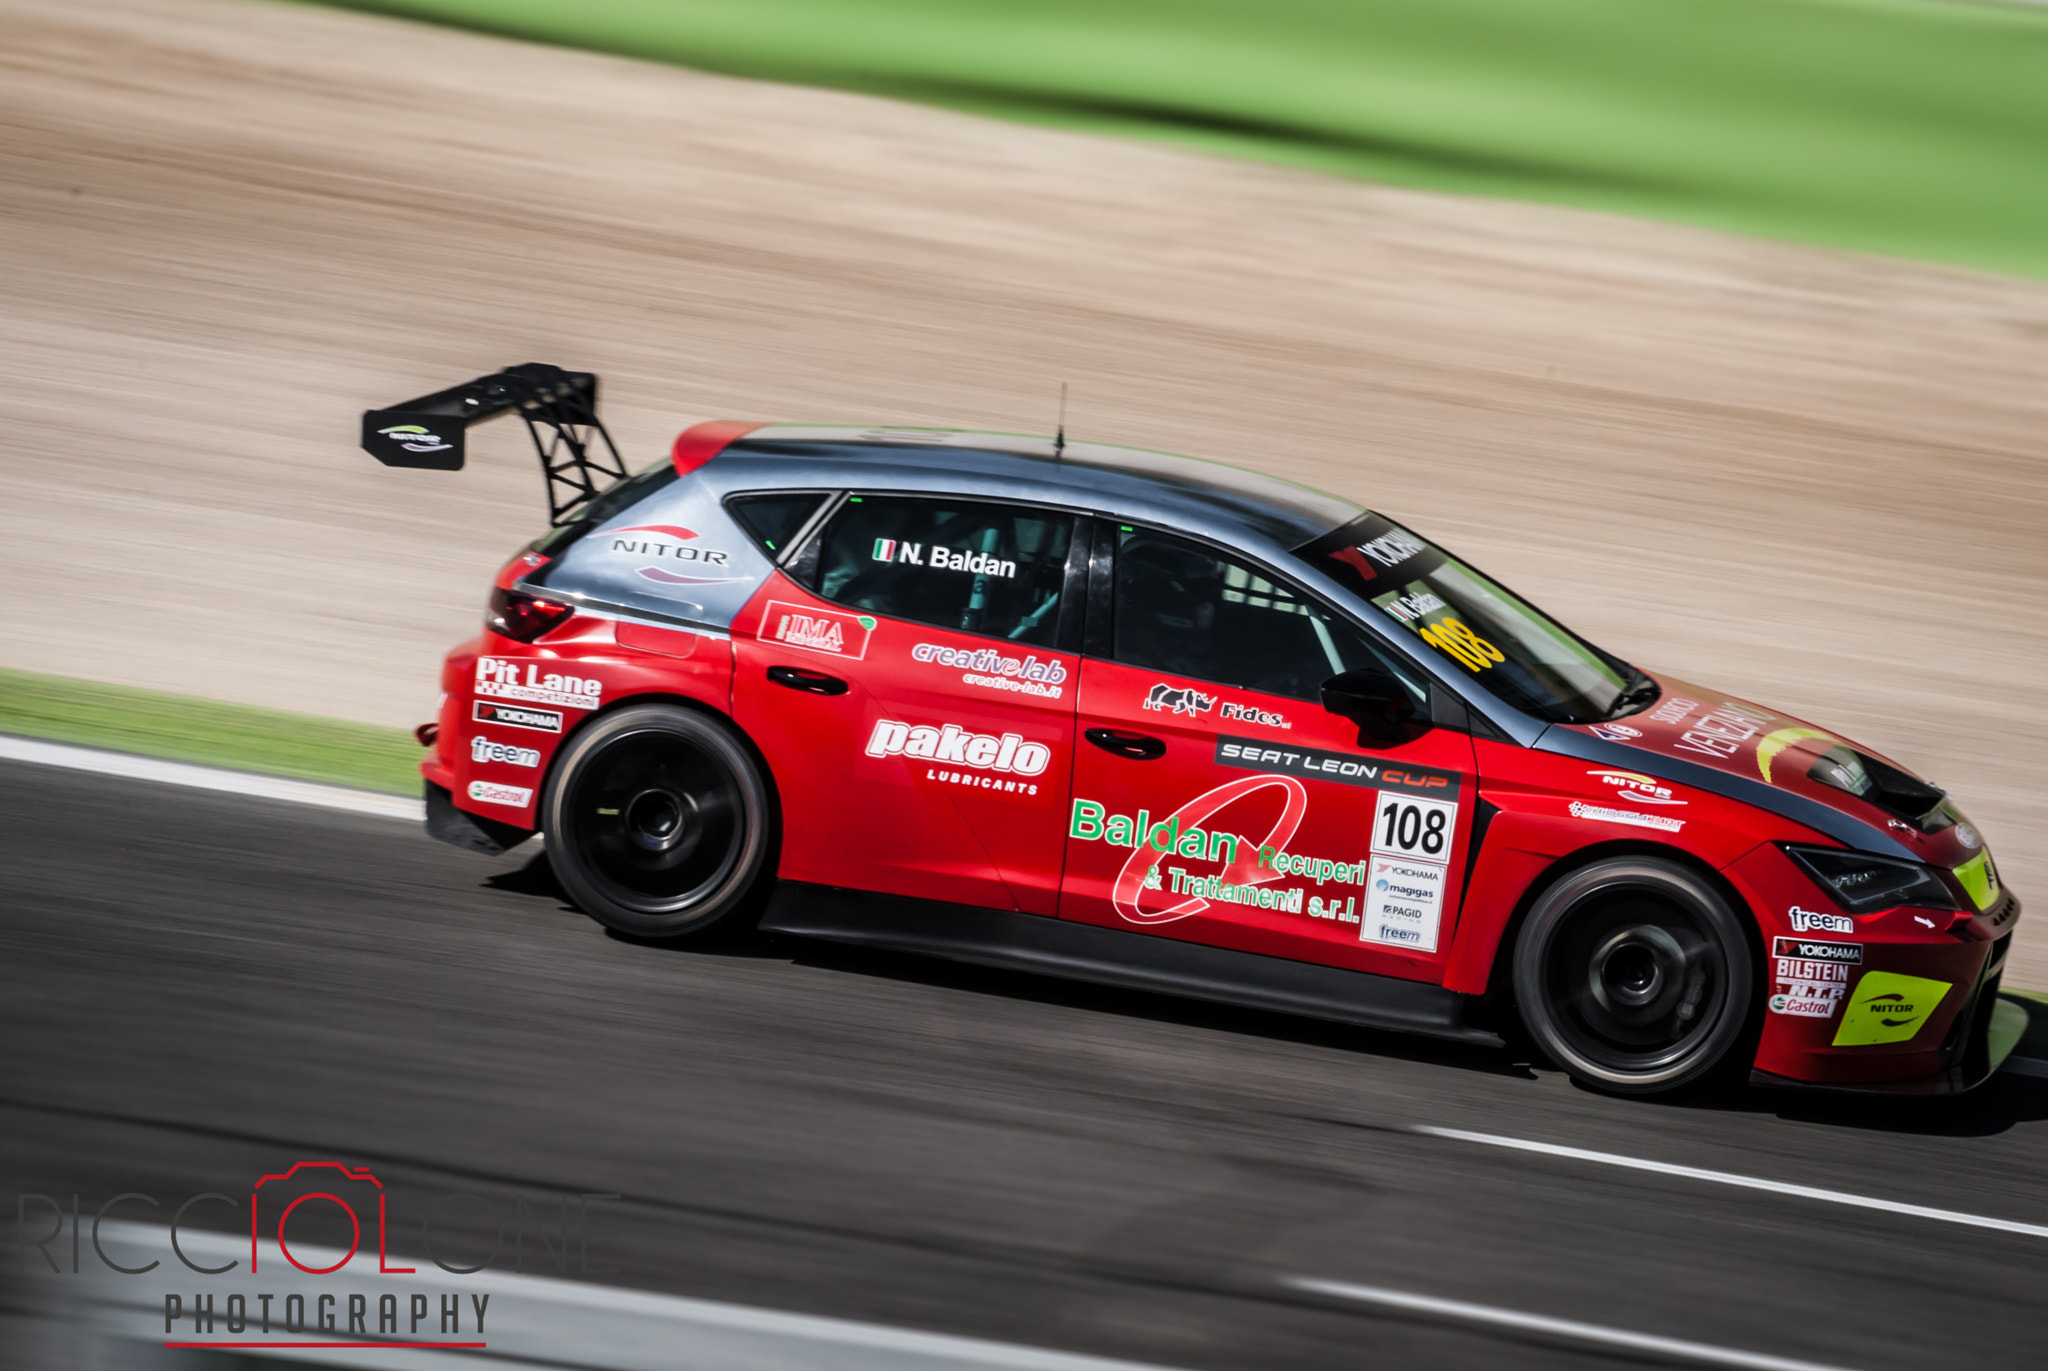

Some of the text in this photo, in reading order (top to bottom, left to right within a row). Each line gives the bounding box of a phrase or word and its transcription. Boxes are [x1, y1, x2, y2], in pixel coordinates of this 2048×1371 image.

[613, 539, 729, 566] NITOR
[899, 541, 1017, 579] N. Baldan
[1419, 617, 1505, 673] 108
[476, 656, 602, 696] Pit Lane
[963, 673, 1062, 699] creative-lab.it
[495, 708, 559, 728] YOKOHAMA
[1220, 702, 1283, 727] Fides
[472, 737, 539, 766] freem
[865, 719, 1051, 776] pakelo
[1221, 743, 1449, 788] SEAT LEON CUP
[927, 769, 1038, 795] LUBRICANTS
[1602, 775, 1673, 797] NITOR
[1383, 802, 1446, 855] 108
[1070, 798, 1367, 887] Baldan Recuperi
[1392, 866, 1439, 881] YOKOHAMA
[1143, 864, 1360, 924] & Trattamenti s.r.l.
[1390, 884, 1434, 899] magigas
[1392, 905, 1422, 919] PAGID
[1790, 907, 1853, 932] freem
[1380, 925, 1420, 942] freem
[1798, 944, 1860, 961] YOKOHAMA
[1777, 958, 1848, 981] BILSTEIN
[1786, 999, 1831, 1014] Castrol
[1870, 1003, 1914, 1013] NITOR
